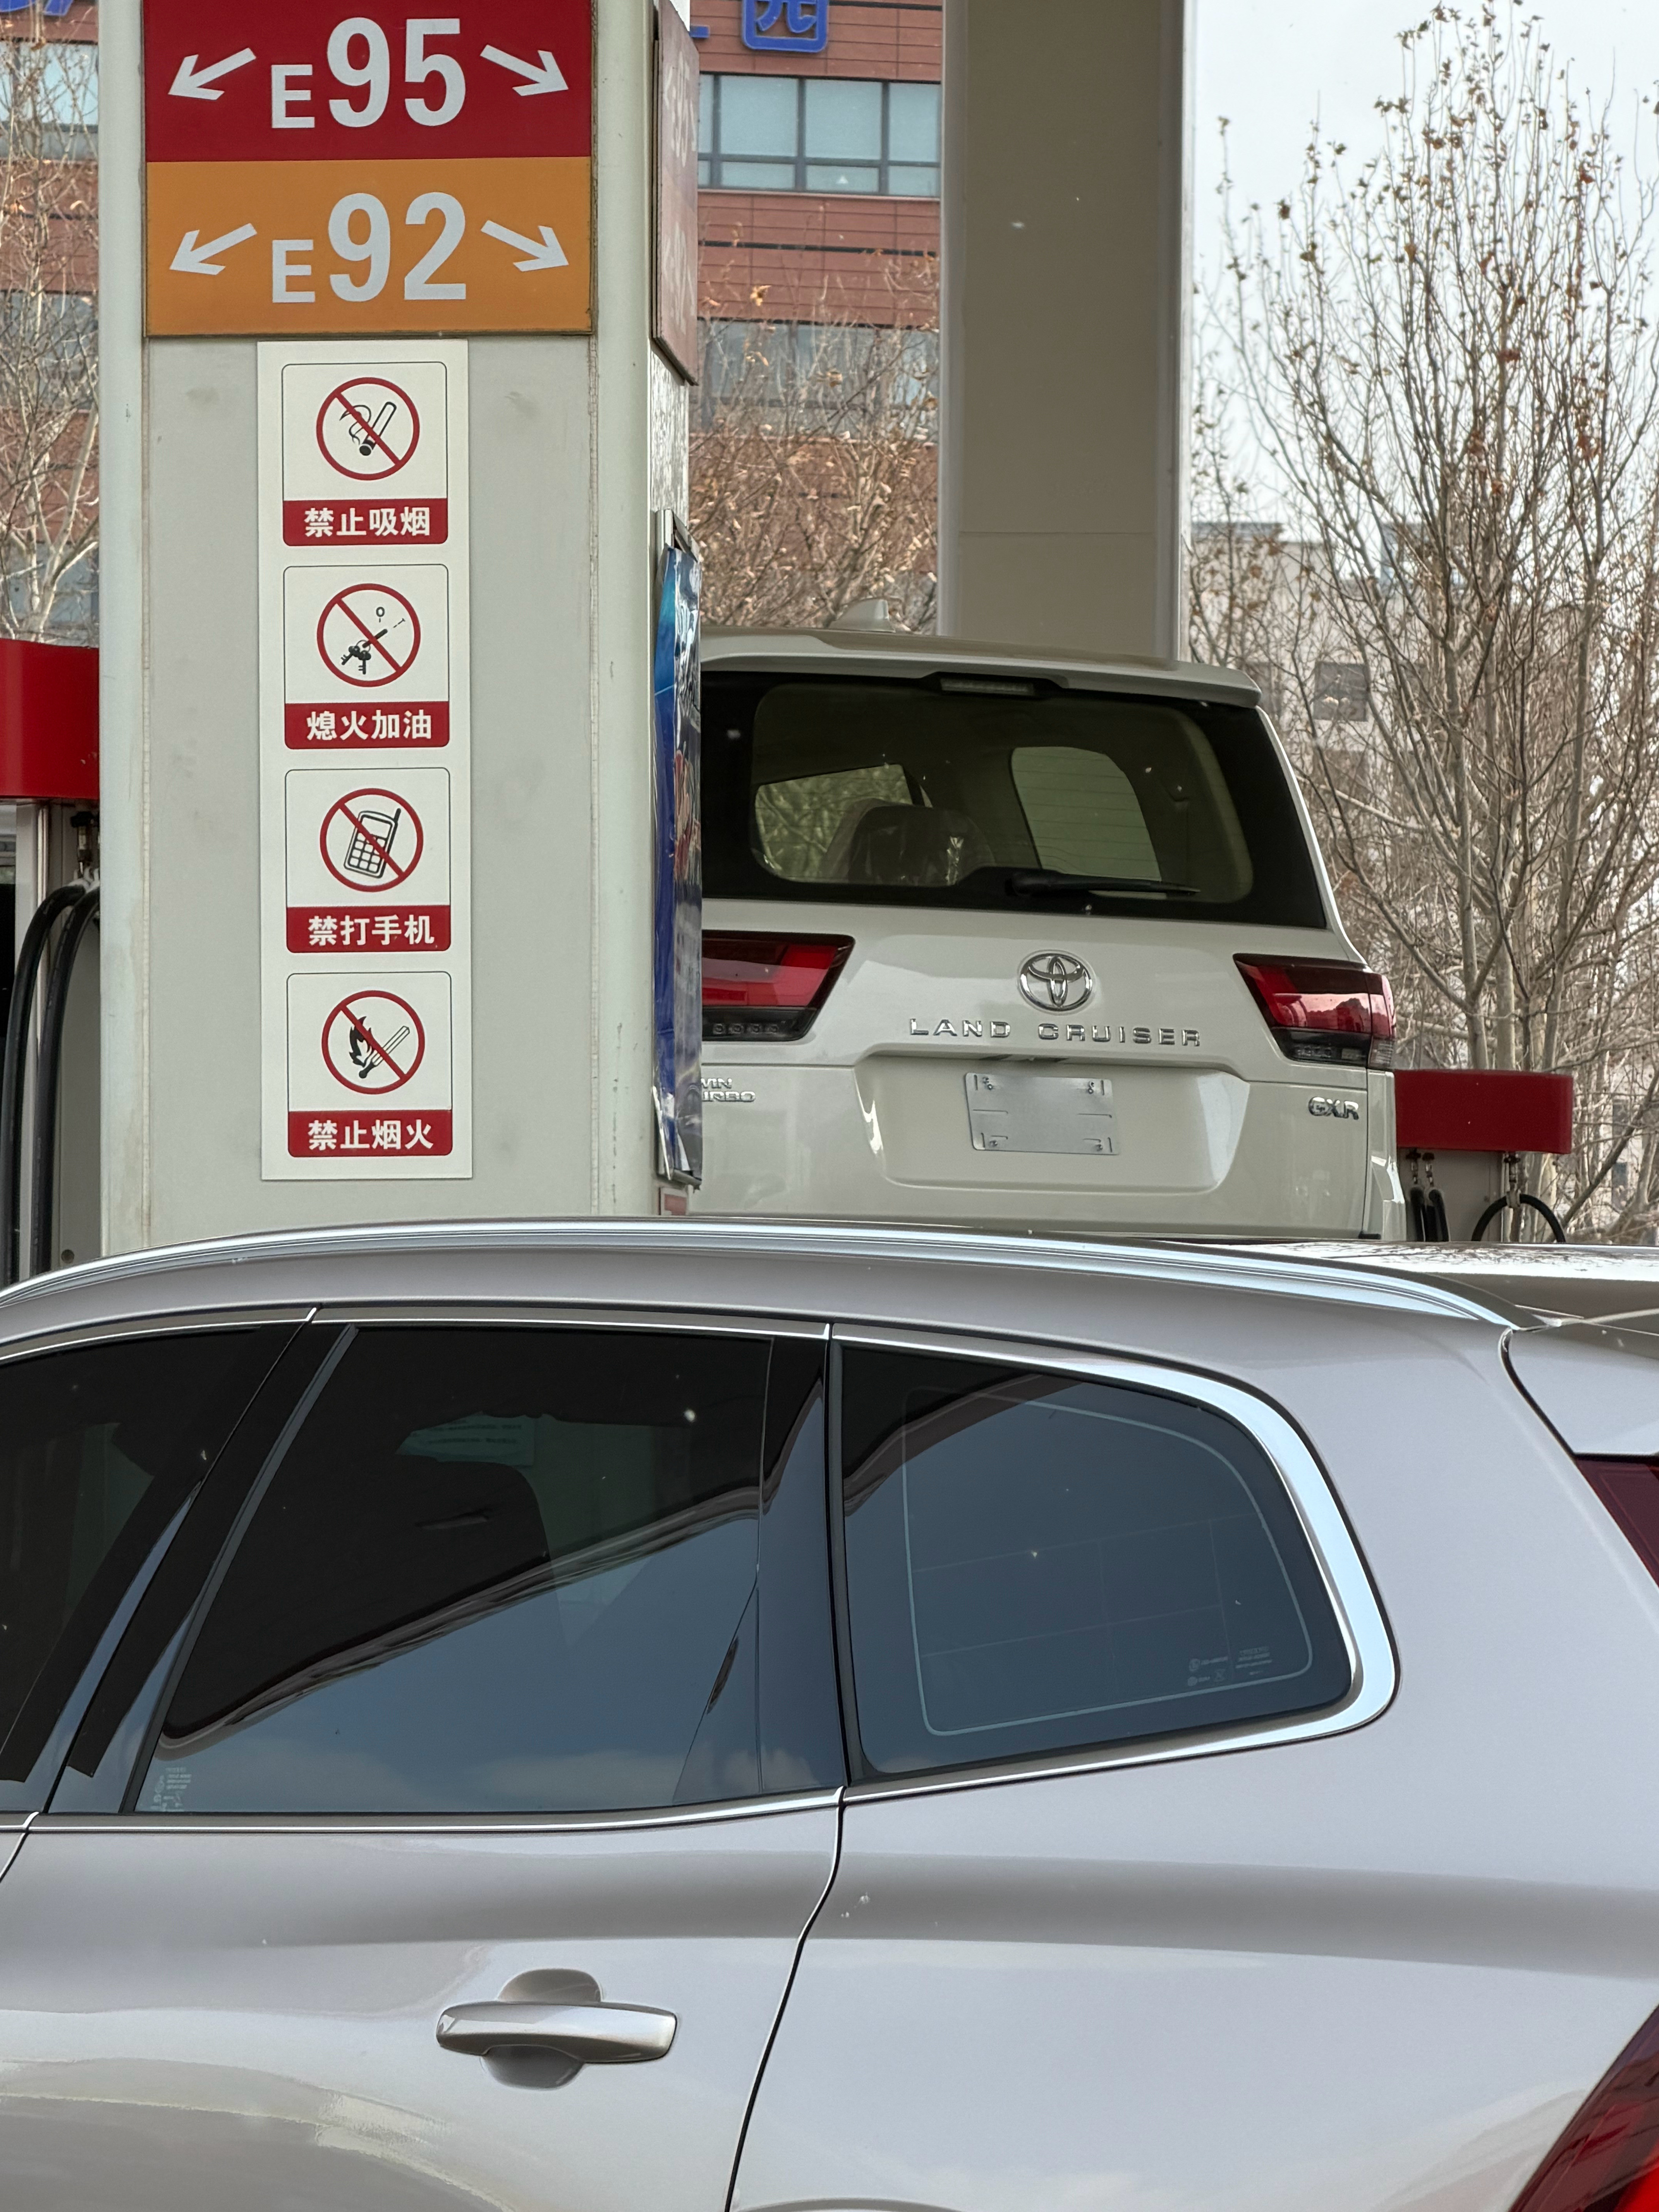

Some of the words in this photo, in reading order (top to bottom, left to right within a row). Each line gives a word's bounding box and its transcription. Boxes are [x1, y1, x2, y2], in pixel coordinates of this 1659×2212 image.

[272, 17, 466, 128] E95
[272, 192, 466, 303] E92
[304, 506, 431, 537] 禁止吸烟
[307, 709, 432, 742] 熄火加油
[308, 914, 434, 946] 禁打手机
[909, 1018, 1011, 1039] LAND
[1038, 1022, 1200, 1047] CRUISER
[308, 1120, 434, 1151] 禁止烟火
